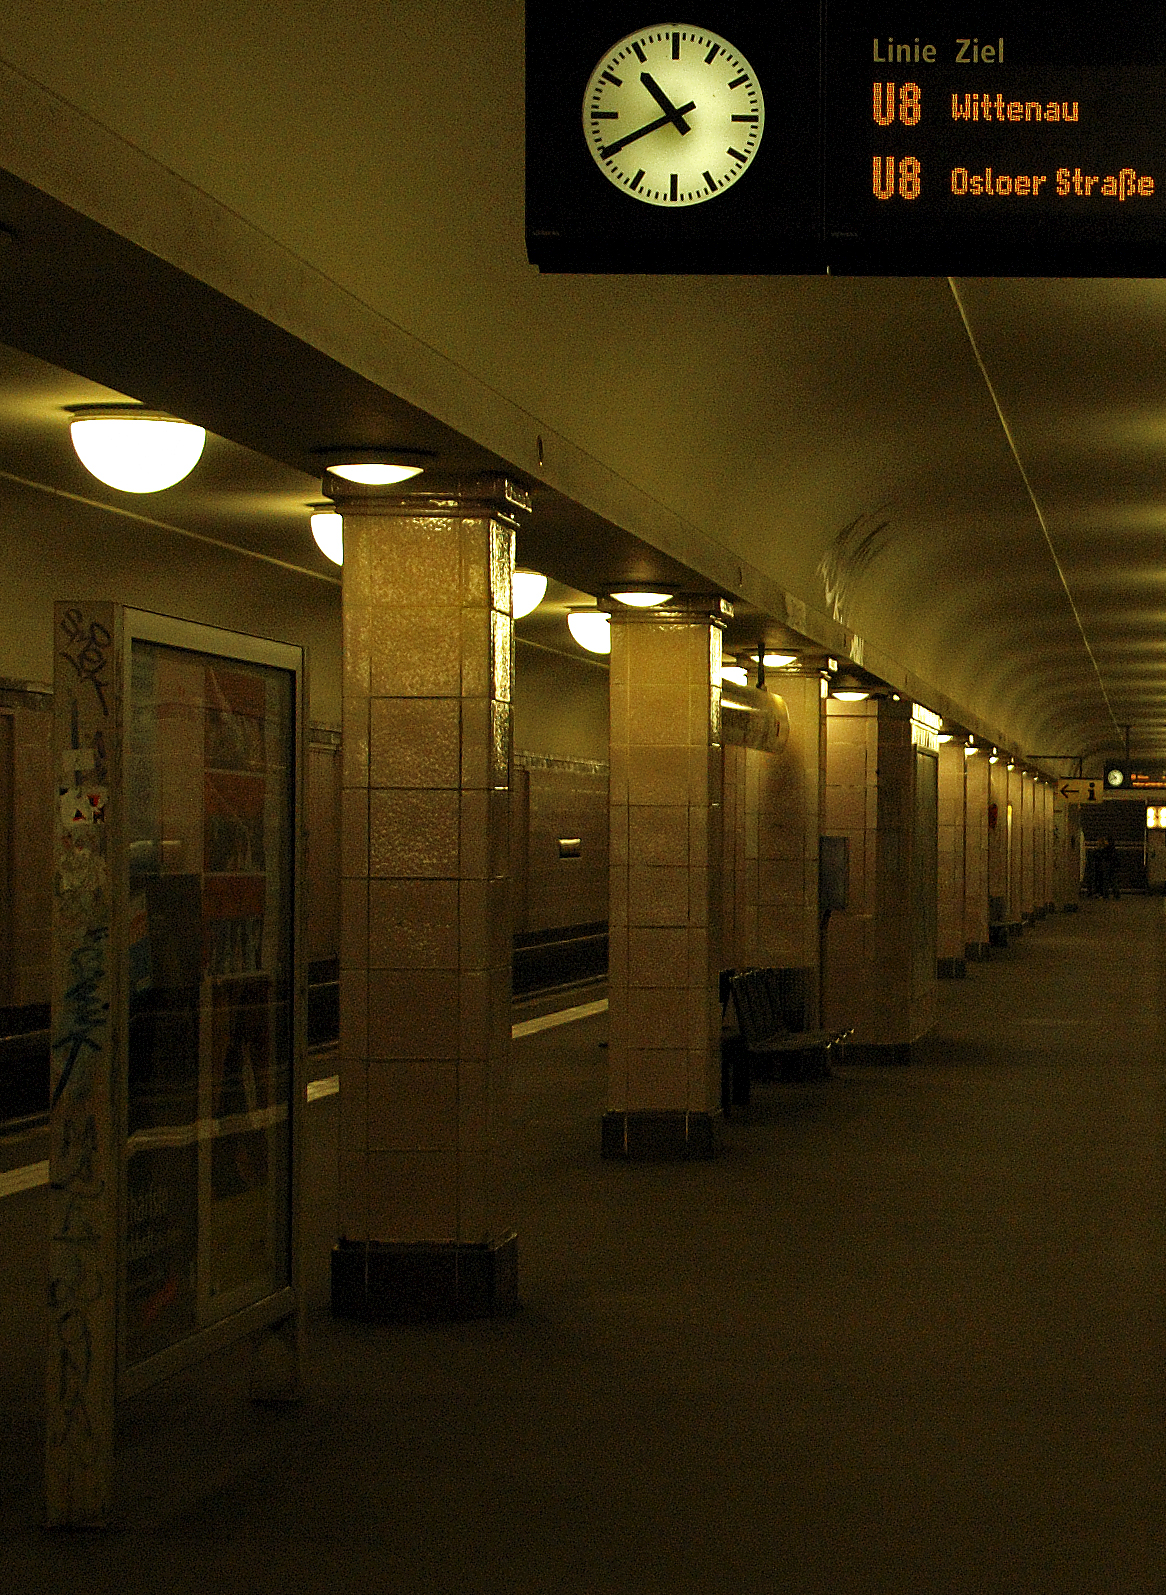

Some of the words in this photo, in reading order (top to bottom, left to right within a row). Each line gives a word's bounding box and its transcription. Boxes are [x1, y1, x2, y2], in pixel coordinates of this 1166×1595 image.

[873, 38, 937, 63] Linie
[955, 38, 1005, 63] Ziel
[872, 82, 922, 127] U8
[950, 93, 1080, 123] Wittenau
[872, 156, 922, 200] U8
[950, 167, 1048, 197] Osloer
[1055, 167, 1156, 203] Straße
